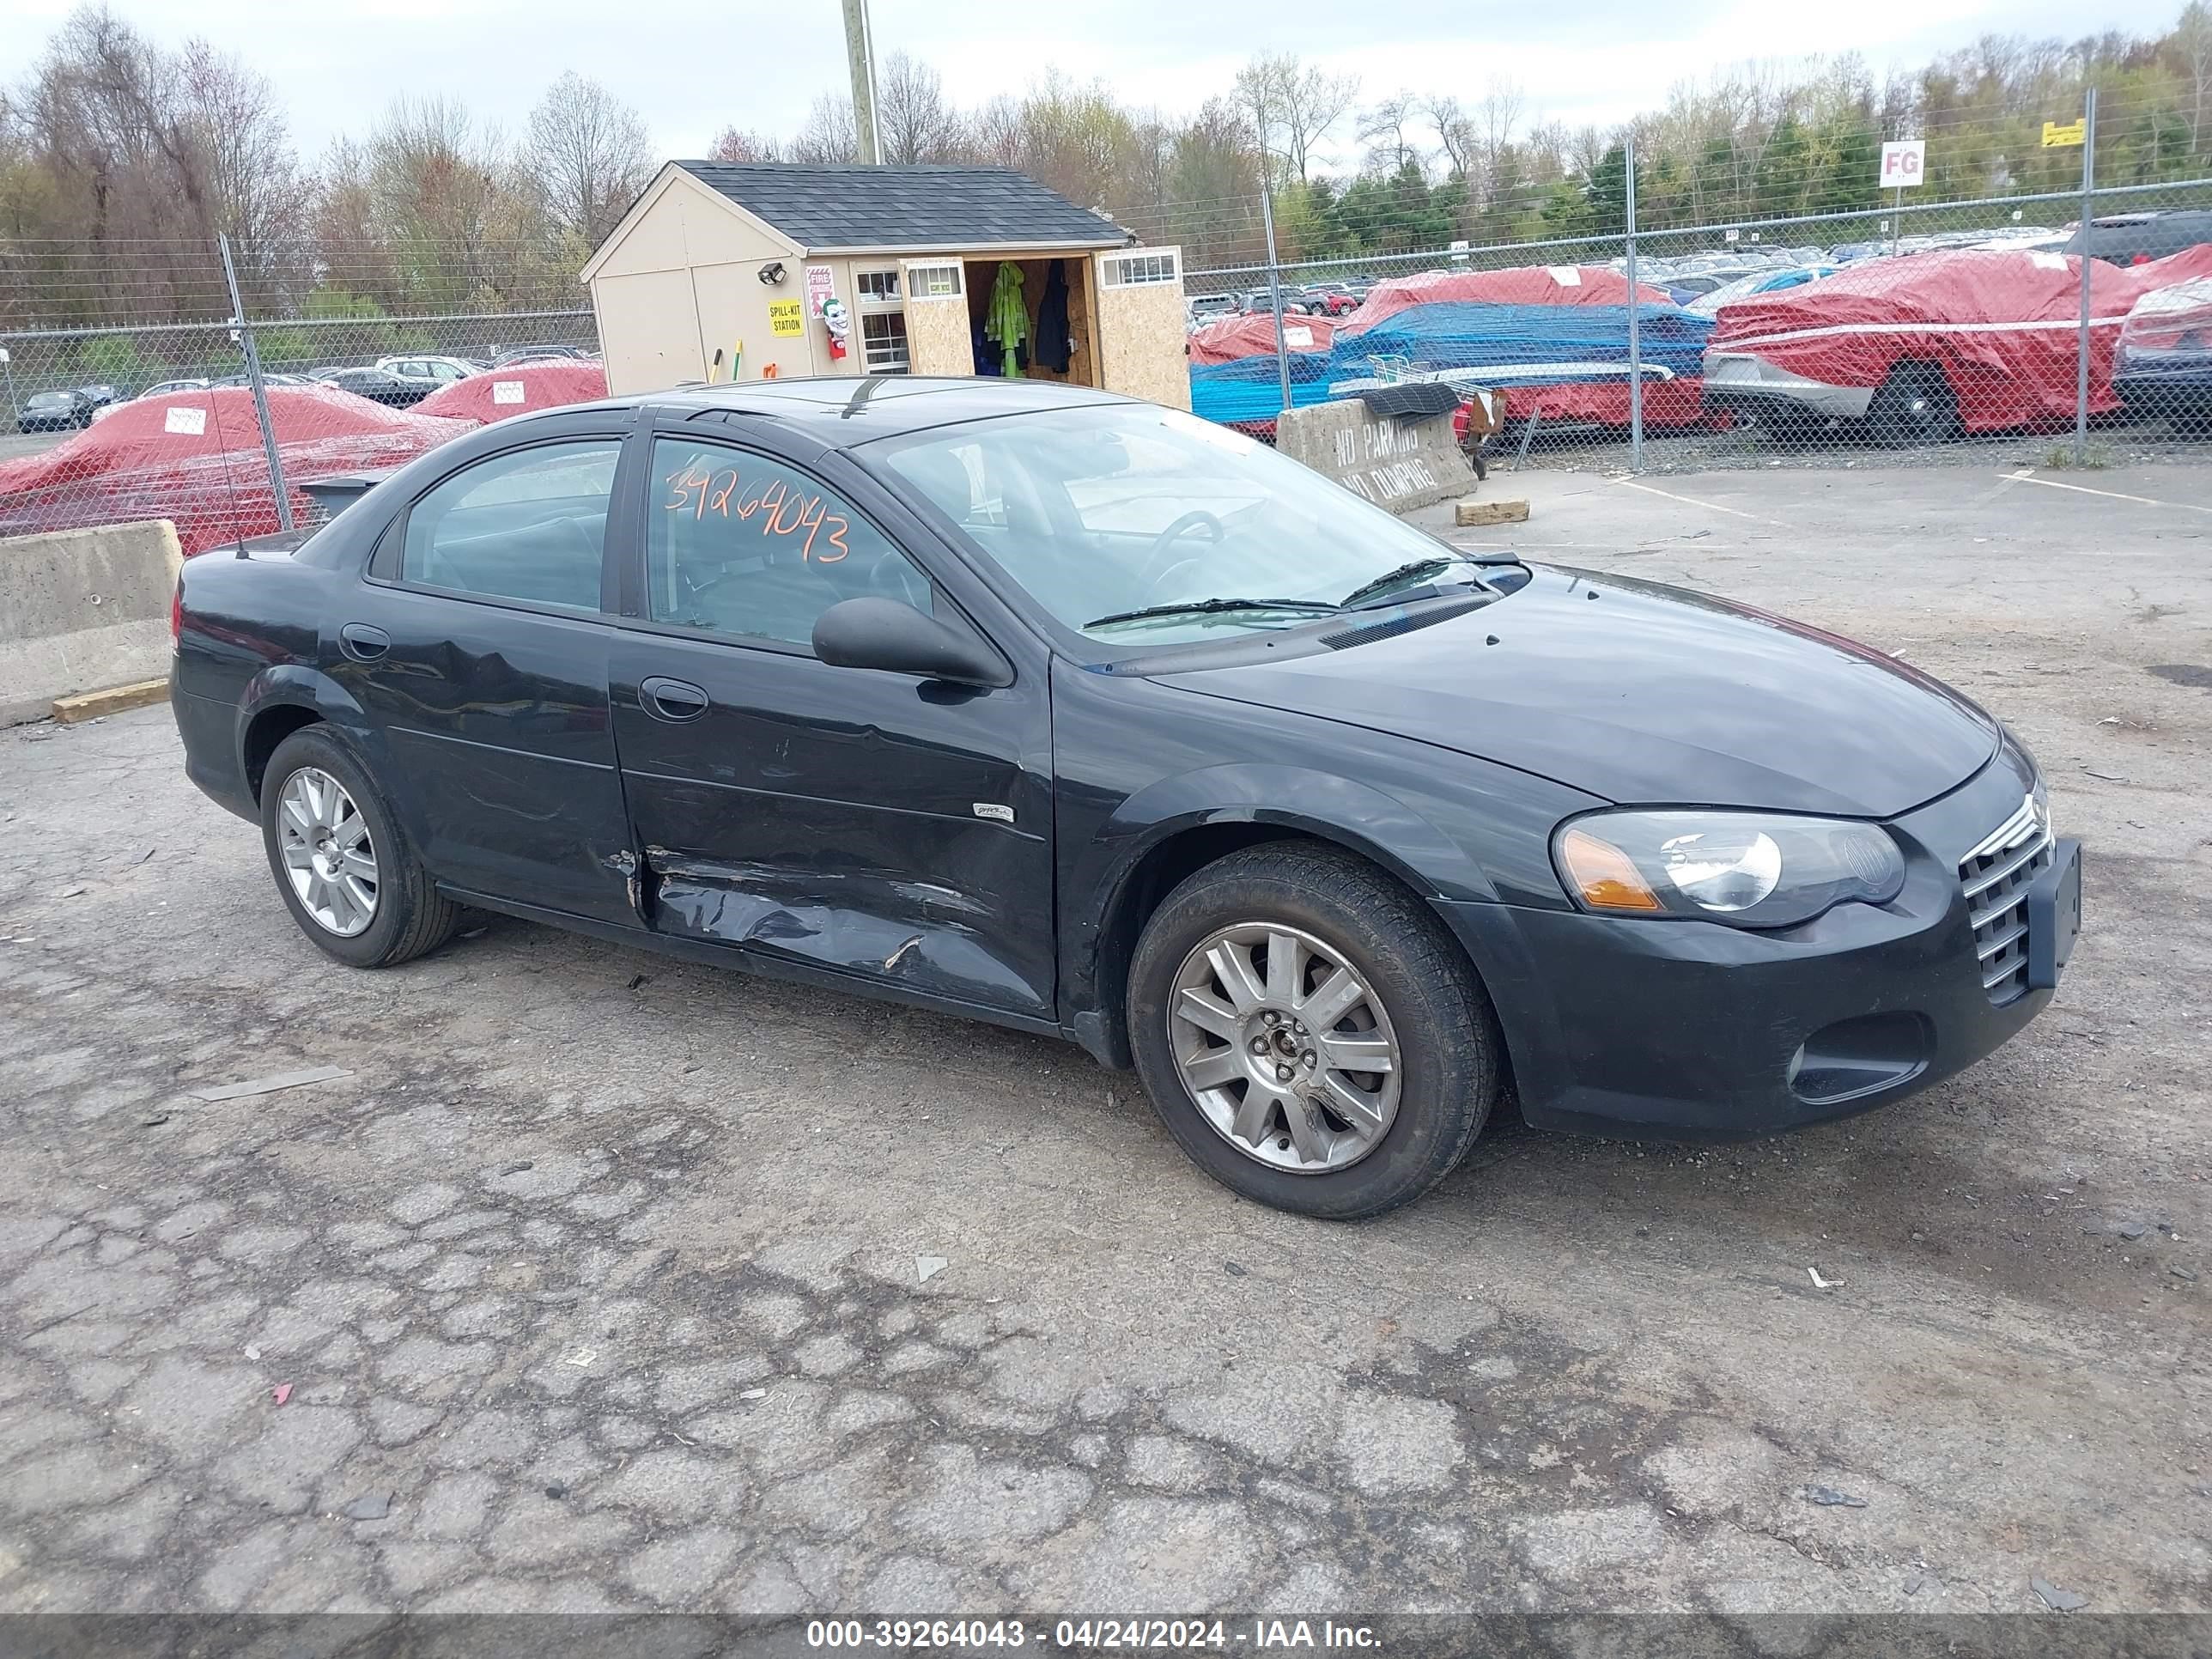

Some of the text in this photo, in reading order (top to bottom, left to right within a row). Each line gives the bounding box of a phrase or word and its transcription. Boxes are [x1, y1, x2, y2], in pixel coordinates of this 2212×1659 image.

[1886, 150, 1918, 174] FG
[811, 274, 830, 283] FIRE
[769, 304, 800, 318] SPILL-KIT
[774, 319, 800, 331] STATION
[1335, 419, 1418, 467] NO PARKING
[665, 467, 849, 562] 39264043
